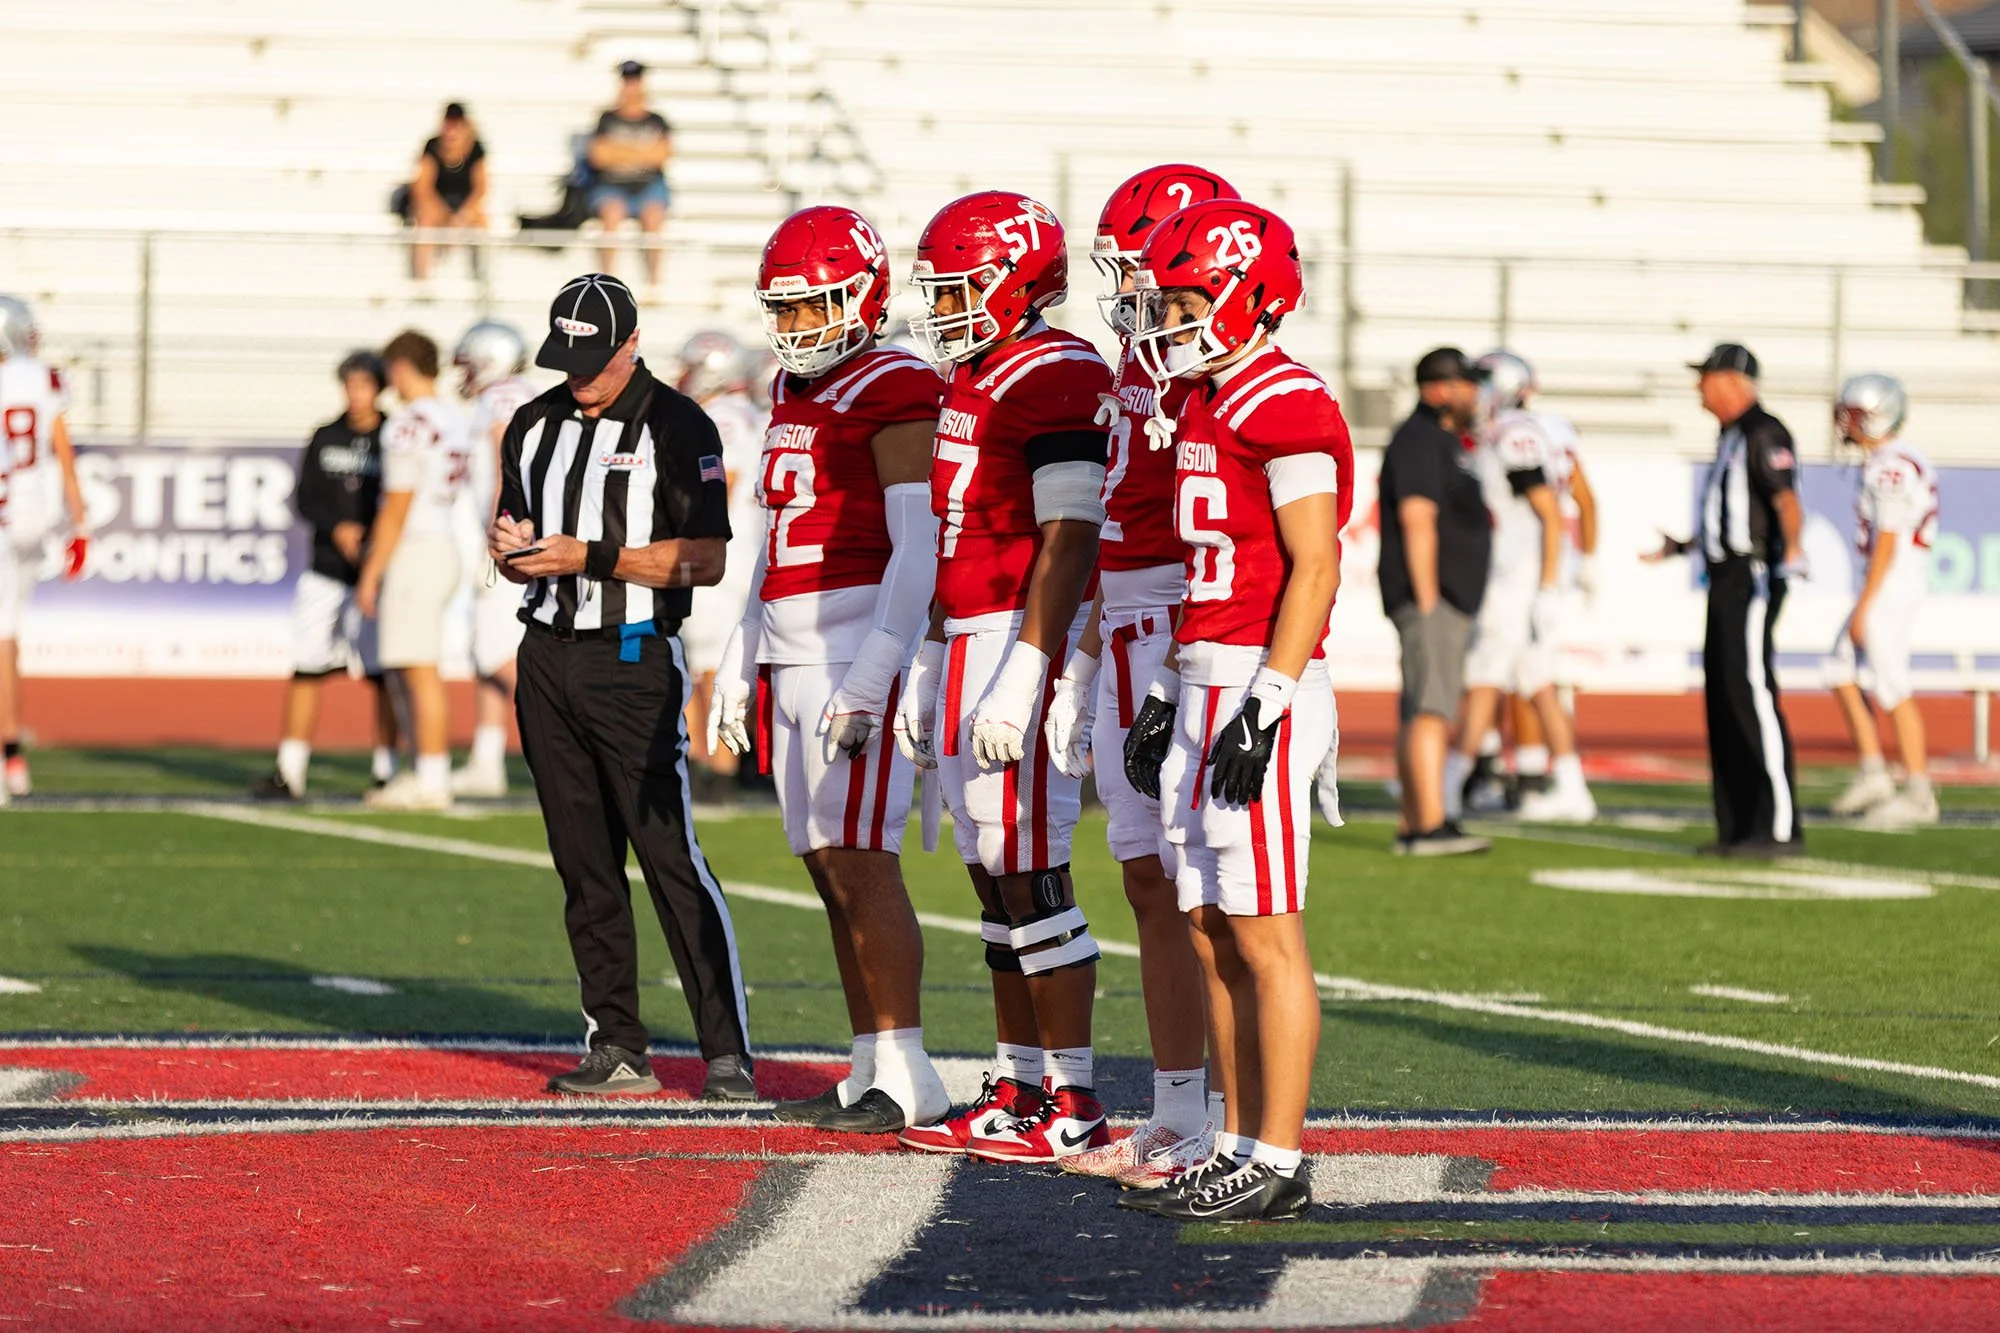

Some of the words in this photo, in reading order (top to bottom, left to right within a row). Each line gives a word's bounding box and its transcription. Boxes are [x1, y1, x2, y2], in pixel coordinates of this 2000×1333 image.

[849, 220, 885, 260] 42
[994, 213, 1041, 258] 57
[1206, 220, 1262, 267] 26
[932, 437, 980, 558] 7
[1174, 475, 1236, 602] 6
